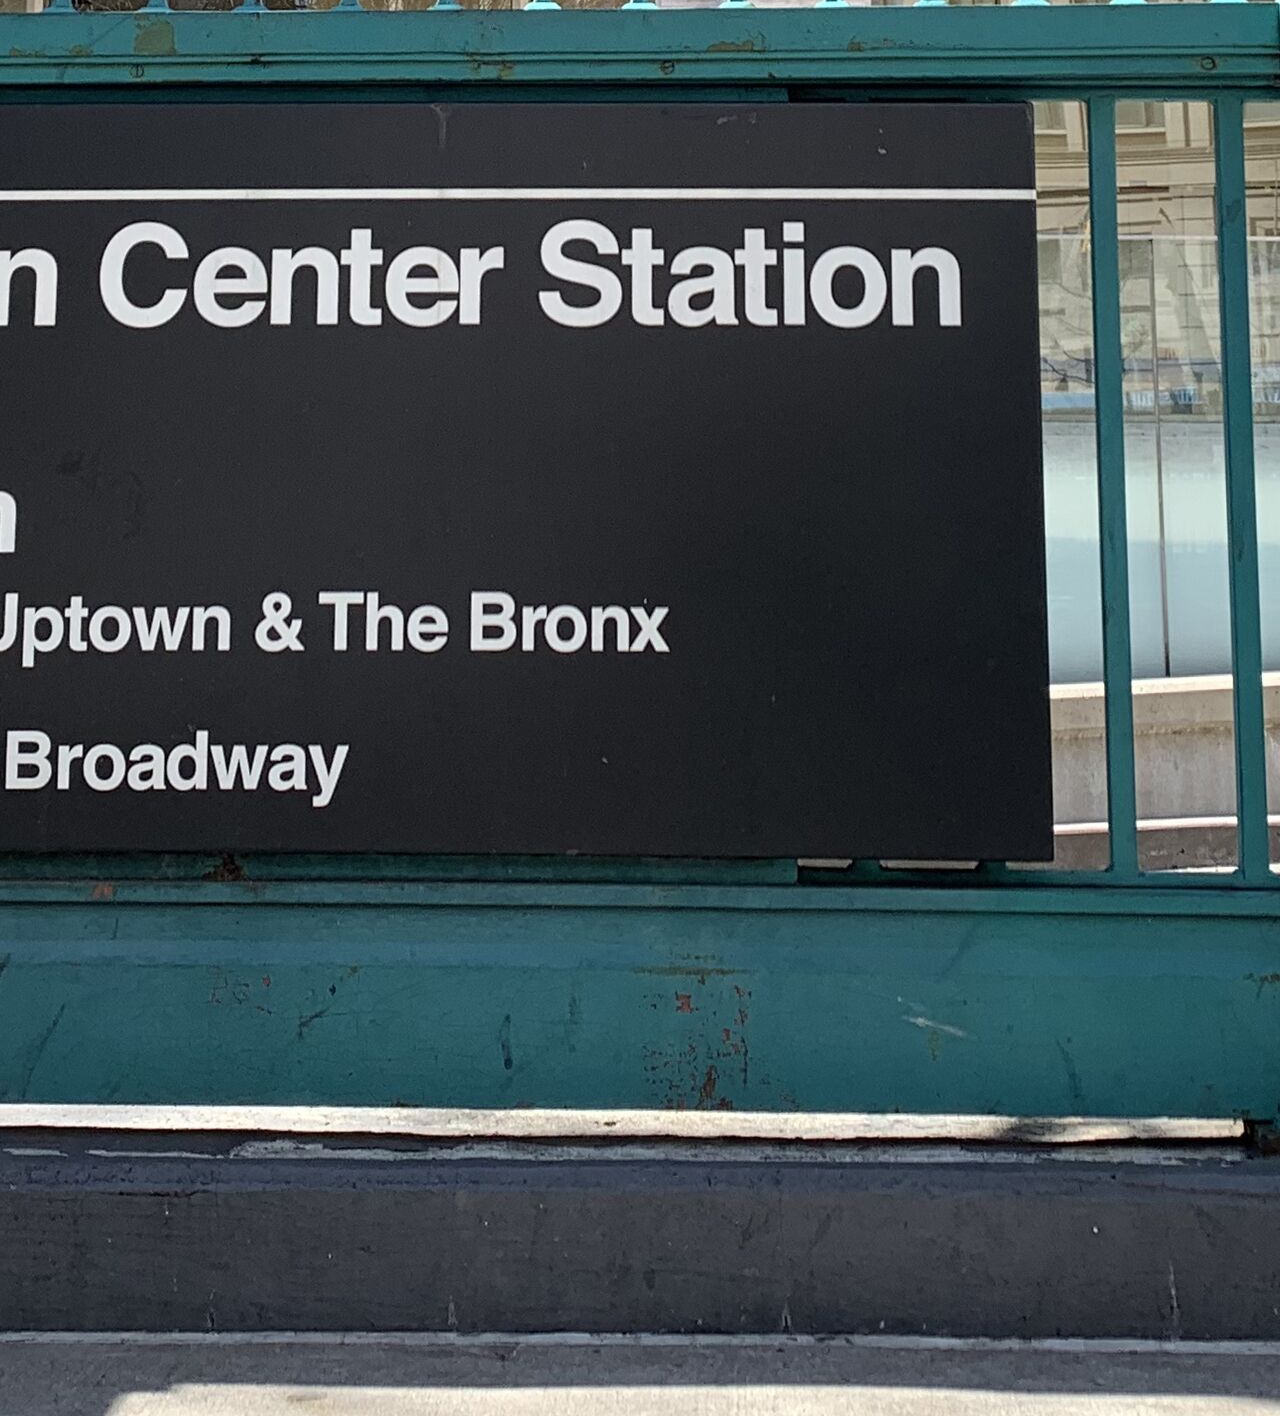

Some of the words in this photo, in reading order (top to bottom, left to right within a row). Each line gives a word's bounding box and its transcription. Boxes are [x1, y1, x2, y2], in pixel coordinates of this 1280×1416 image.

[99, 221, 505, 329] Center
[538, 219, 962, 328] Station
[254, 592, 305, 653] &
[318, 591, 449, 653] The
[470, 591, 670, 653] Bronx
[5, 730, 350, 807] Broadway
